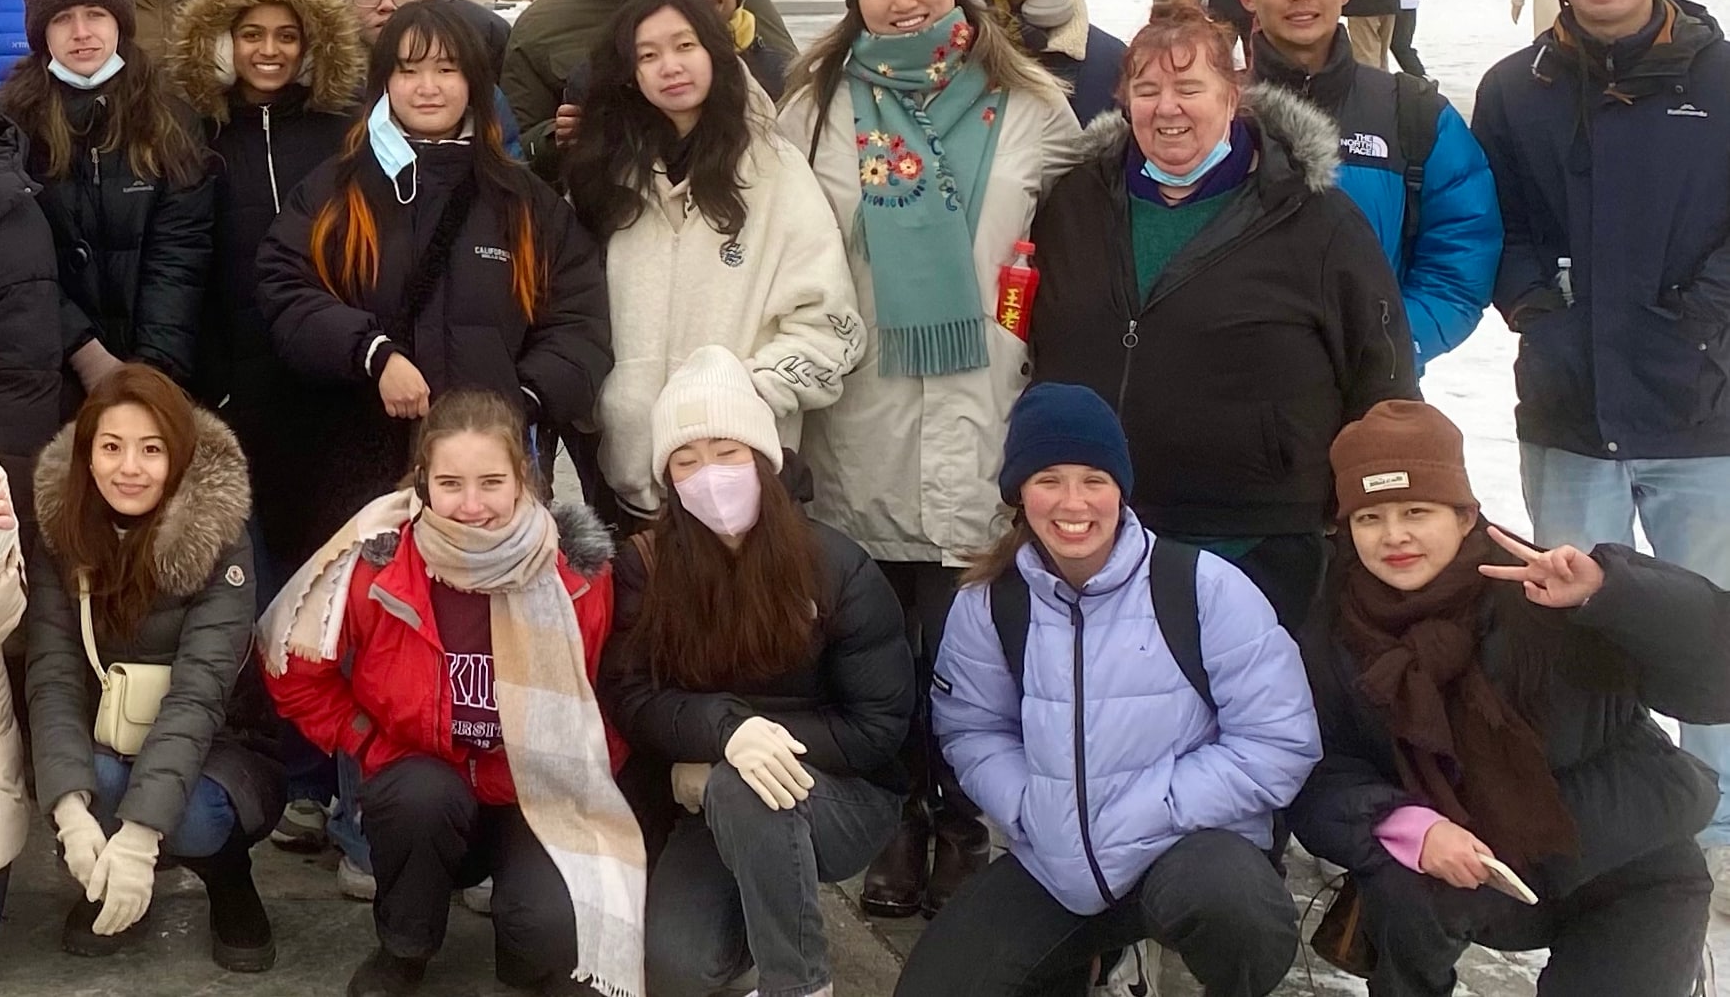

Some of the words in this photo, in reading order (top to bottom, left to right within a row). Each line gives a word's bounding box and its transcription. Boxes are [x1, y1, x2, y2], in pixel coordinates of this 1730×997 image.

[1354, 133, 1373, 143] THE
[1340, 138, 1373, 151] NORTH
[1349, 145, 1373, 156] FACE
